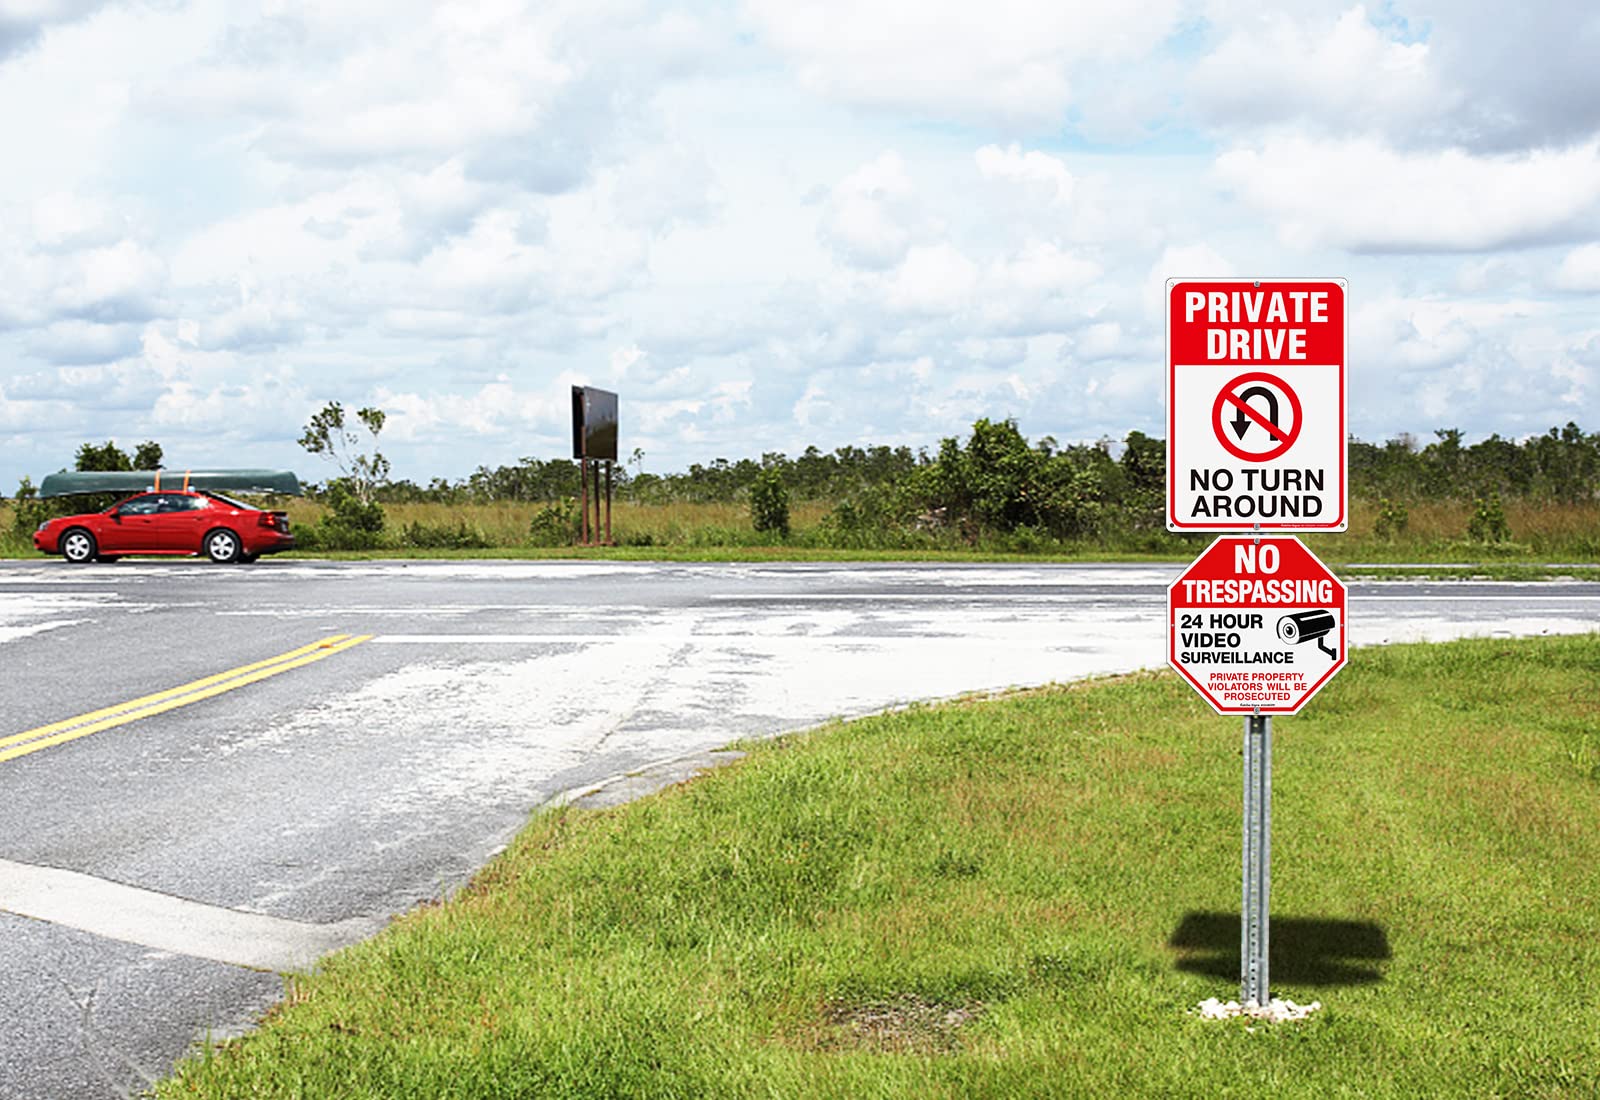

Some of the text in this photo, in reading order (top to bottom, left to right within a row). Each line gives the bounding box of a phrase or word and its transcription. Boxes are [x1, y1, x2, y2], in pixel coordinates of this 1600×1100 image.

[1185, 291, 1329, 323] PRIVATE
[1207, 328, 1307, 360] DRIVE
[1190, 468, 1324, 492] NO TURN
[1190, 495, 1323, 518] AROUND
[1234, 544, 1280, 574] NO
[1182, 579, 1333, 603] TRESPASSING
[1180, 614, 1264, 629] 24 HOUR
[1181, 632, 1241, 648] VIDEO
[1180, 651, 1294, 664] SURVEILLANCE
[1210, 672, 1304, 681] PRIVATE PROPERTY
[1208, 682, 1308, 691] VIOLATORS WILL BE
[1223, 692, 1291, 701] PROSECUTED
